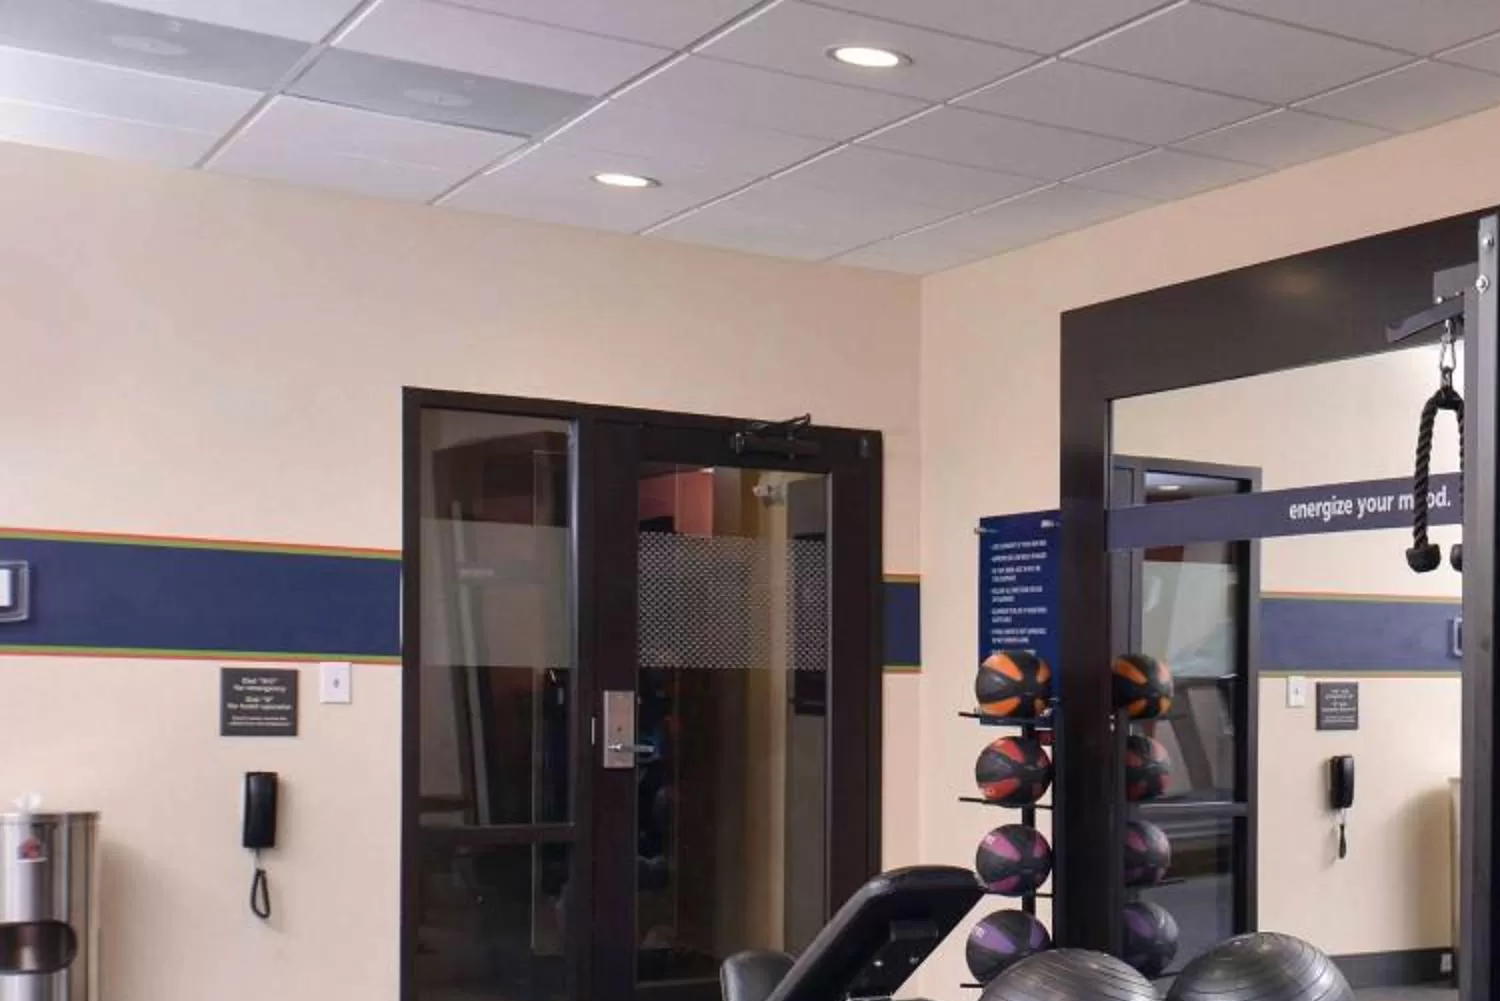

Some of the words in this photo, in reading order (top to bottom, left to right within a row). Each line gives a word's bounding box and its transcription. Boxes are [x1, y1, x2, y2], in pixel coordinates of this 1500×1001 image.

[1289, 495, 1353, 523] energize
[1356, 494, 1395, 519] your
[1398, 485, 1452, 511] mod.
